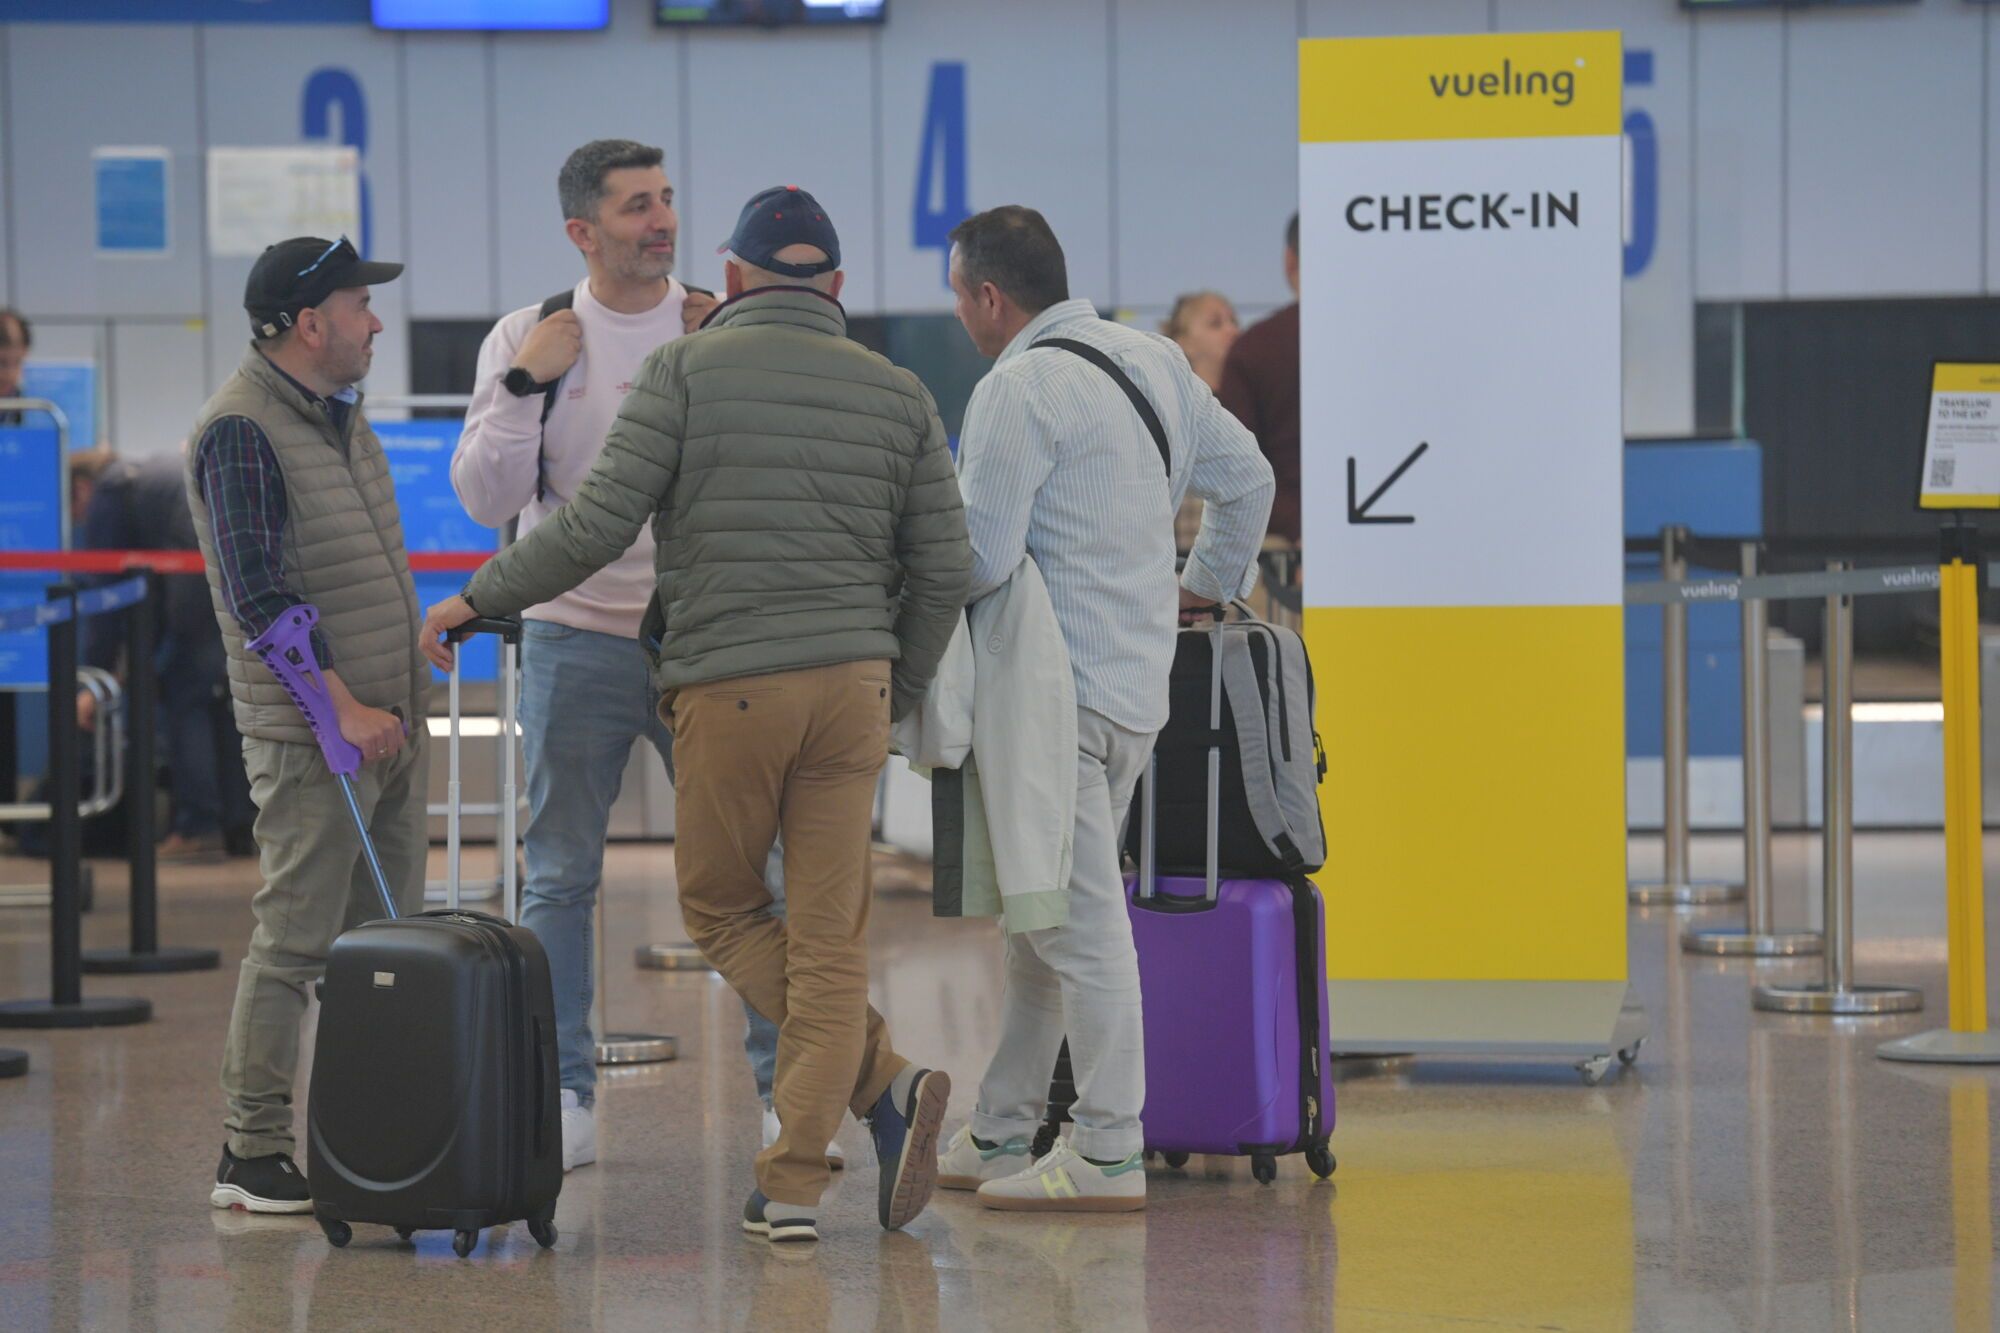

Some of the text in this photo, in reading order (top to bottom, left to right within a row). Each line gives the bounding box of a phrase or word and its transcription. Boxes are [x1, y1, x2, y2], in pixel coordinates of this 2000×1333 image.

[1429, 58, 1576, 107] vueling
[912, 61, 970, 286] 4
[1345, 191, 1579, 232] CHECK-IN
[1680, 580, 1740, 600] vueling
